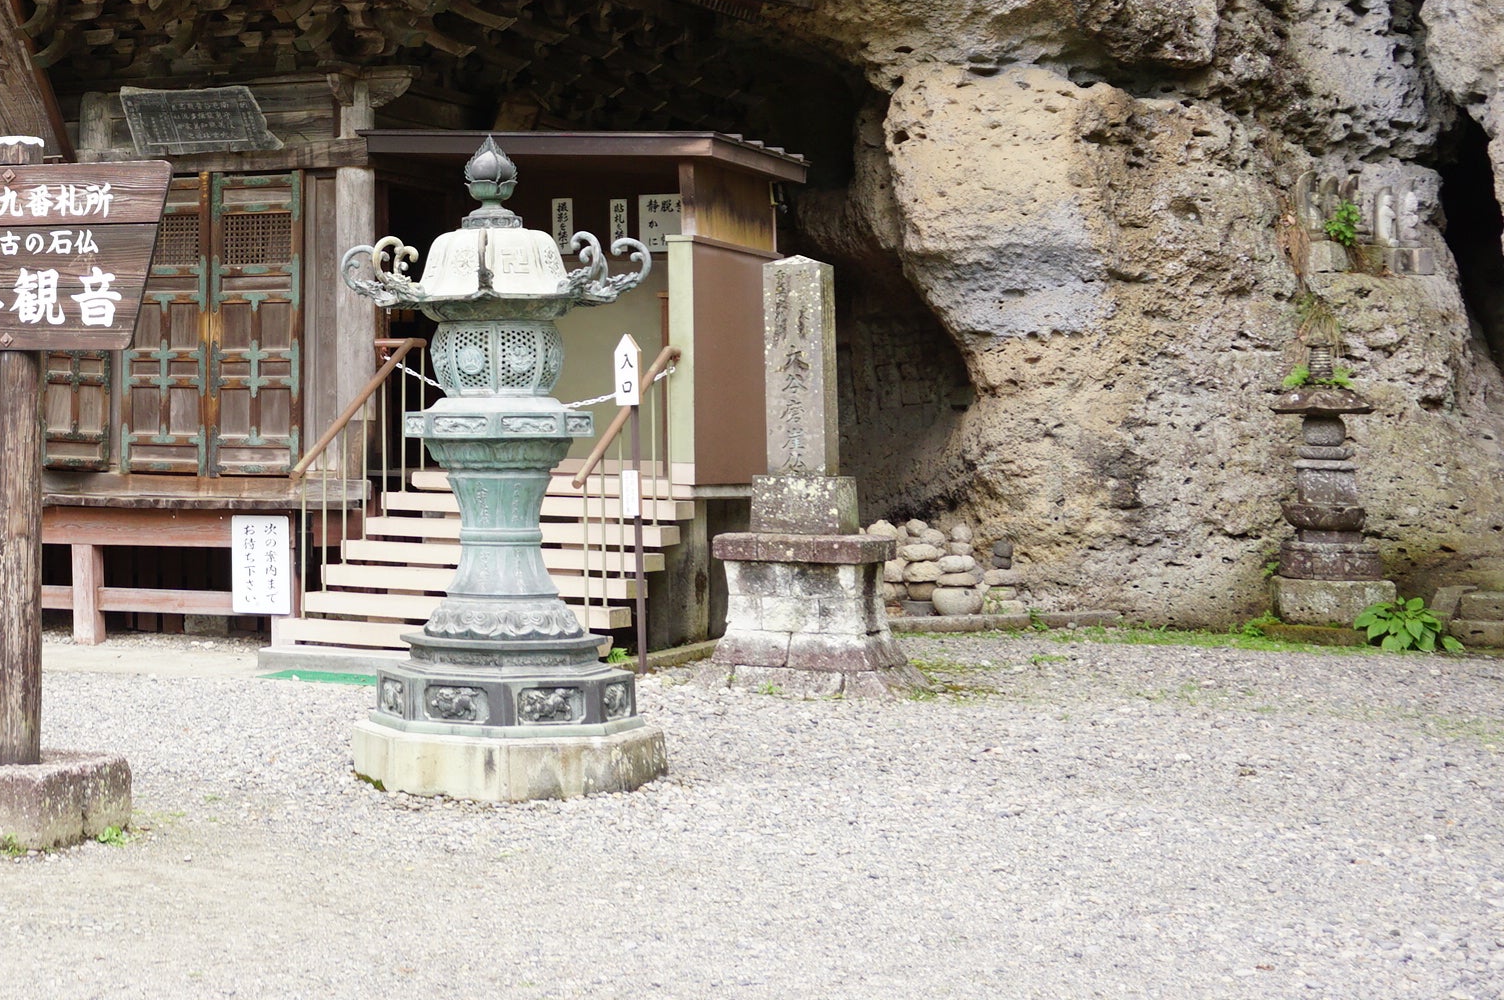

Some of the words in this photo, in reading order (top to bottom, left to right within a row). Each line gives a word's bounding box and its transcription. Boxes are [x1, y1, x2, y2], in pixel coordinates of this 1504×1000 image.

[620, 353, 634, 393] 入口
[244, 524, 257, 603] お待ち下さい
